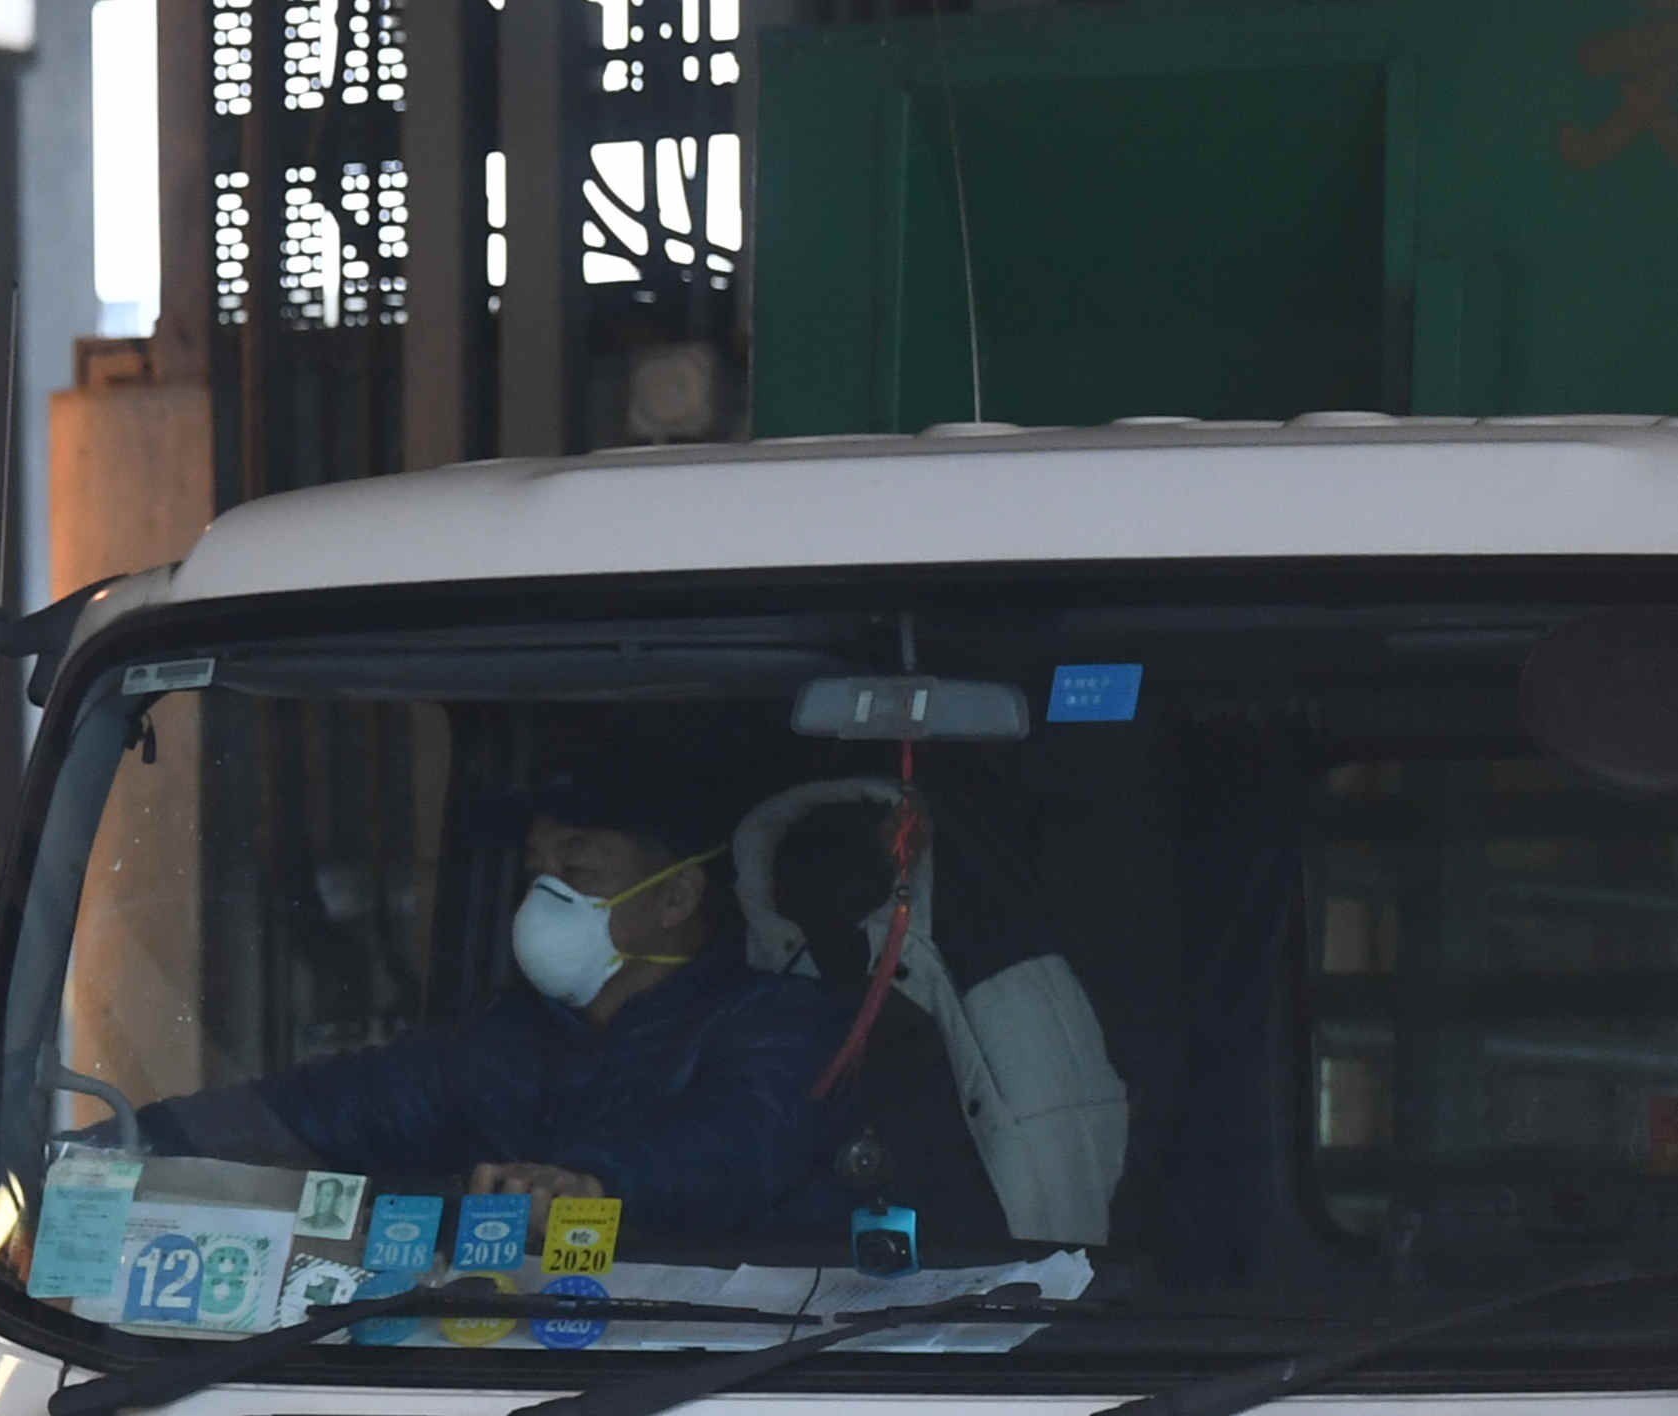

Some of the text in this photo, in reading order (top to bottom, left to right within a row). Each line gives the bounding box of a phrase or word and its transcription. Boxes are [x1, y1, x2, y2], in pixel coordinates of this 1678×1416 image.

[370, 1242, 427, 1265] 2018
[460, 1242, 517, 1265] 2019
[549, 1248, 607, 1272] 2020
[137, 1248, 199, 1307] 12
